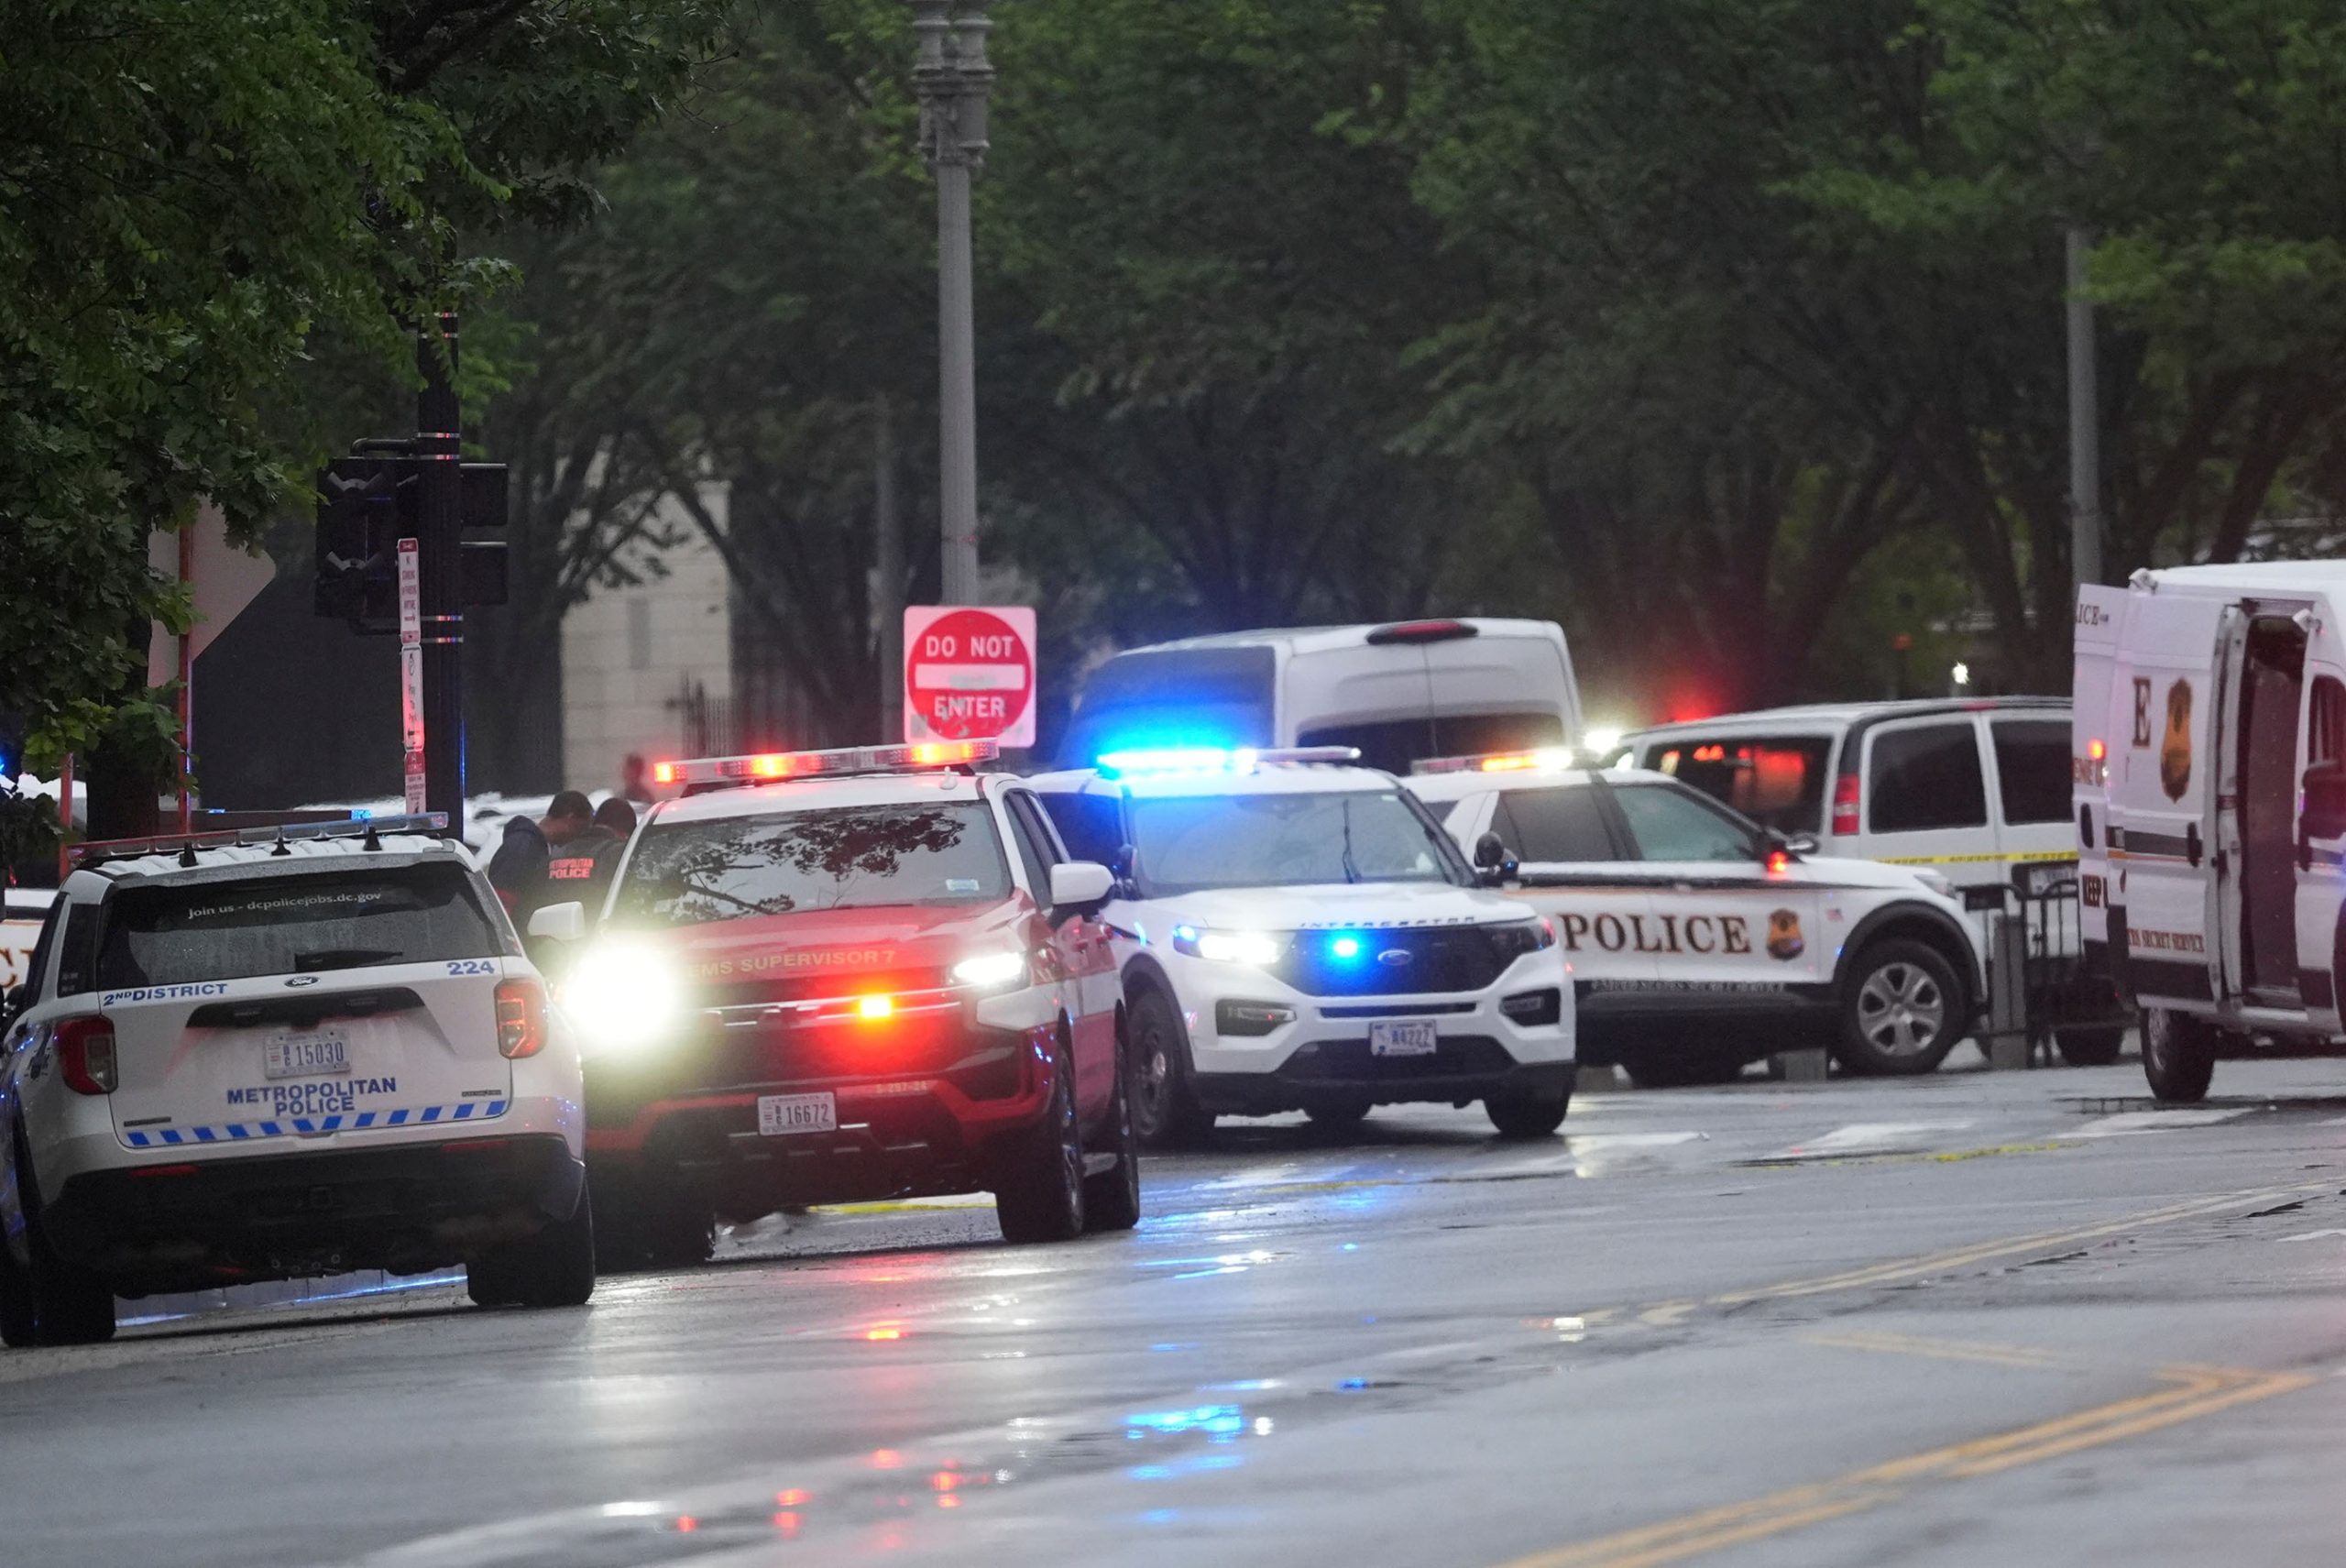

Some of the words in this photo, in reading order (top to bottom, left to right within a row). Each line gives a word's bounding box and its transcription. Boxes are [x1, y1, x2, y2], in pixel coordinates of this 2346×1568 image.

[926, 635, 956, 657] DO
[970, 635, 1014, 658] NOT
[934, 696, 1005, 718] ENTER
[549, 867, 590, 879] POLICE
[219, 905, 235, 914] us
[247, 891, 382, 912] dcpolicejobs.dc.gov
[1557, 912, 1752, 955] POLICE
[446, 960, 495, 976] 224
[688, 960, 733, 980] EMS
[740, 950, 878, 973] SUPERVISOR
[882, 950, 895, 964] 7
[132, 982, 227, 1002] DISTRICT
[296, 1041, 345, 1067] 15030
[227, 1077, 396, 1105] METROPOLITAN
[275, 1096, 355, 1117] POLICE
[785, 1103, 829, 1124] 16672
